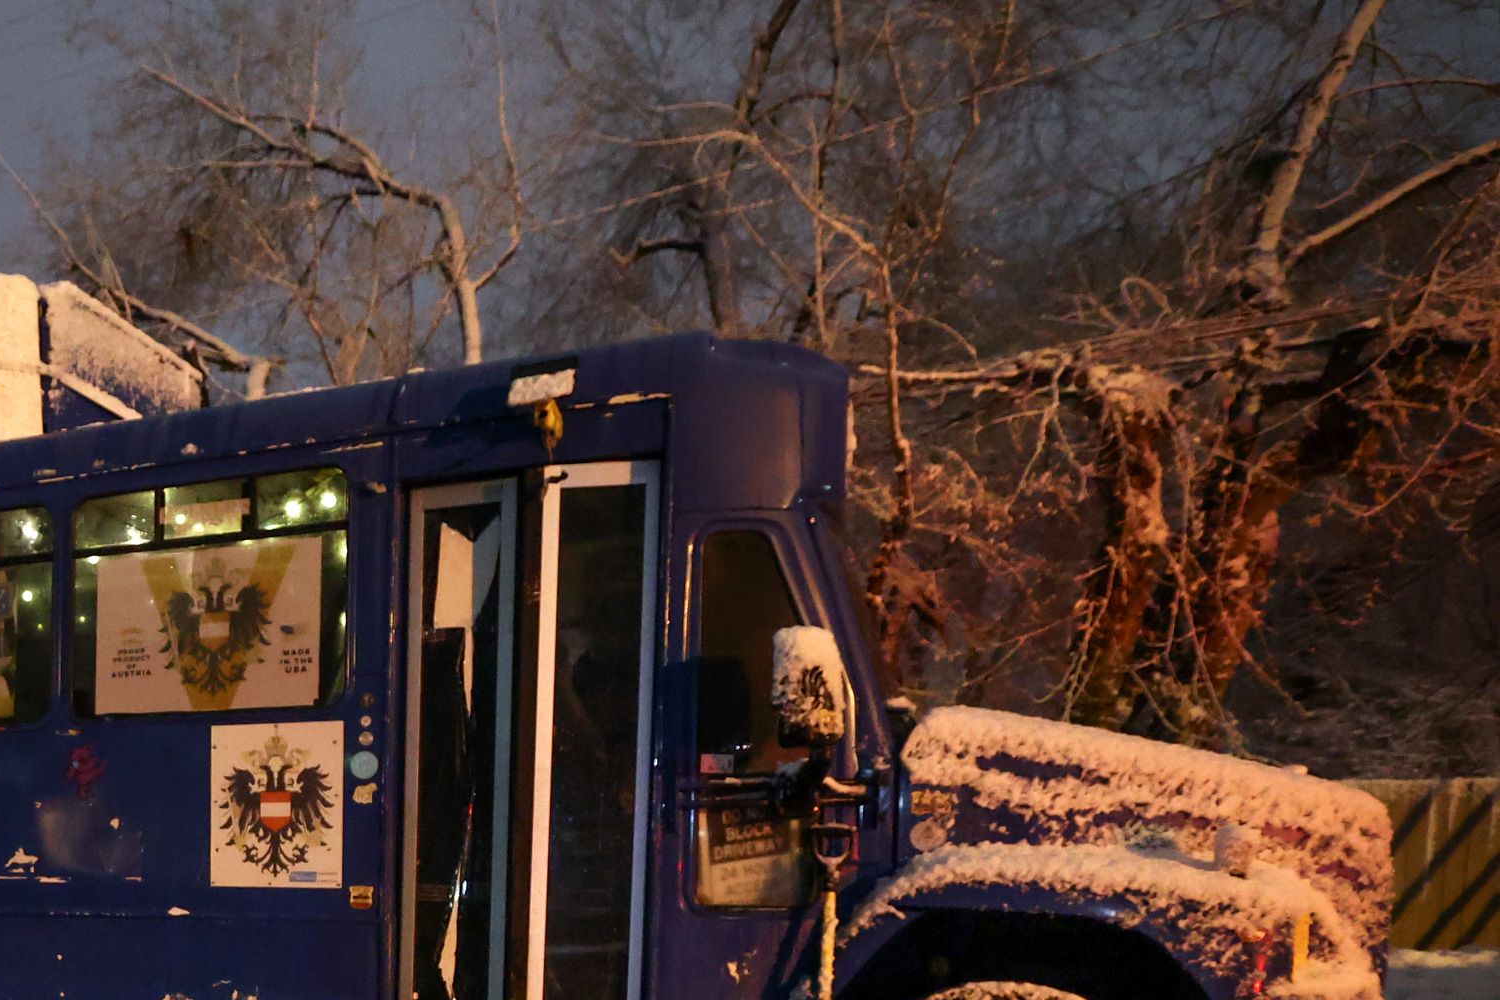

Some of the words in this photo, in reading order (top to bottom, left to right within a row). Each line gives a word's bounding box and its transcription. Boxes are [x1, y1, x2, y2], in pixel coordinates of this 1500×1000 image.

[282, 648, 311, 656] MADE
[293, 656, 313, 664] THE
[111, 669, 152, 678] AUSTRIA
[725, 822, 773, 842] BLOCK
[713, 837, 785, 860] DRIVEWAY
